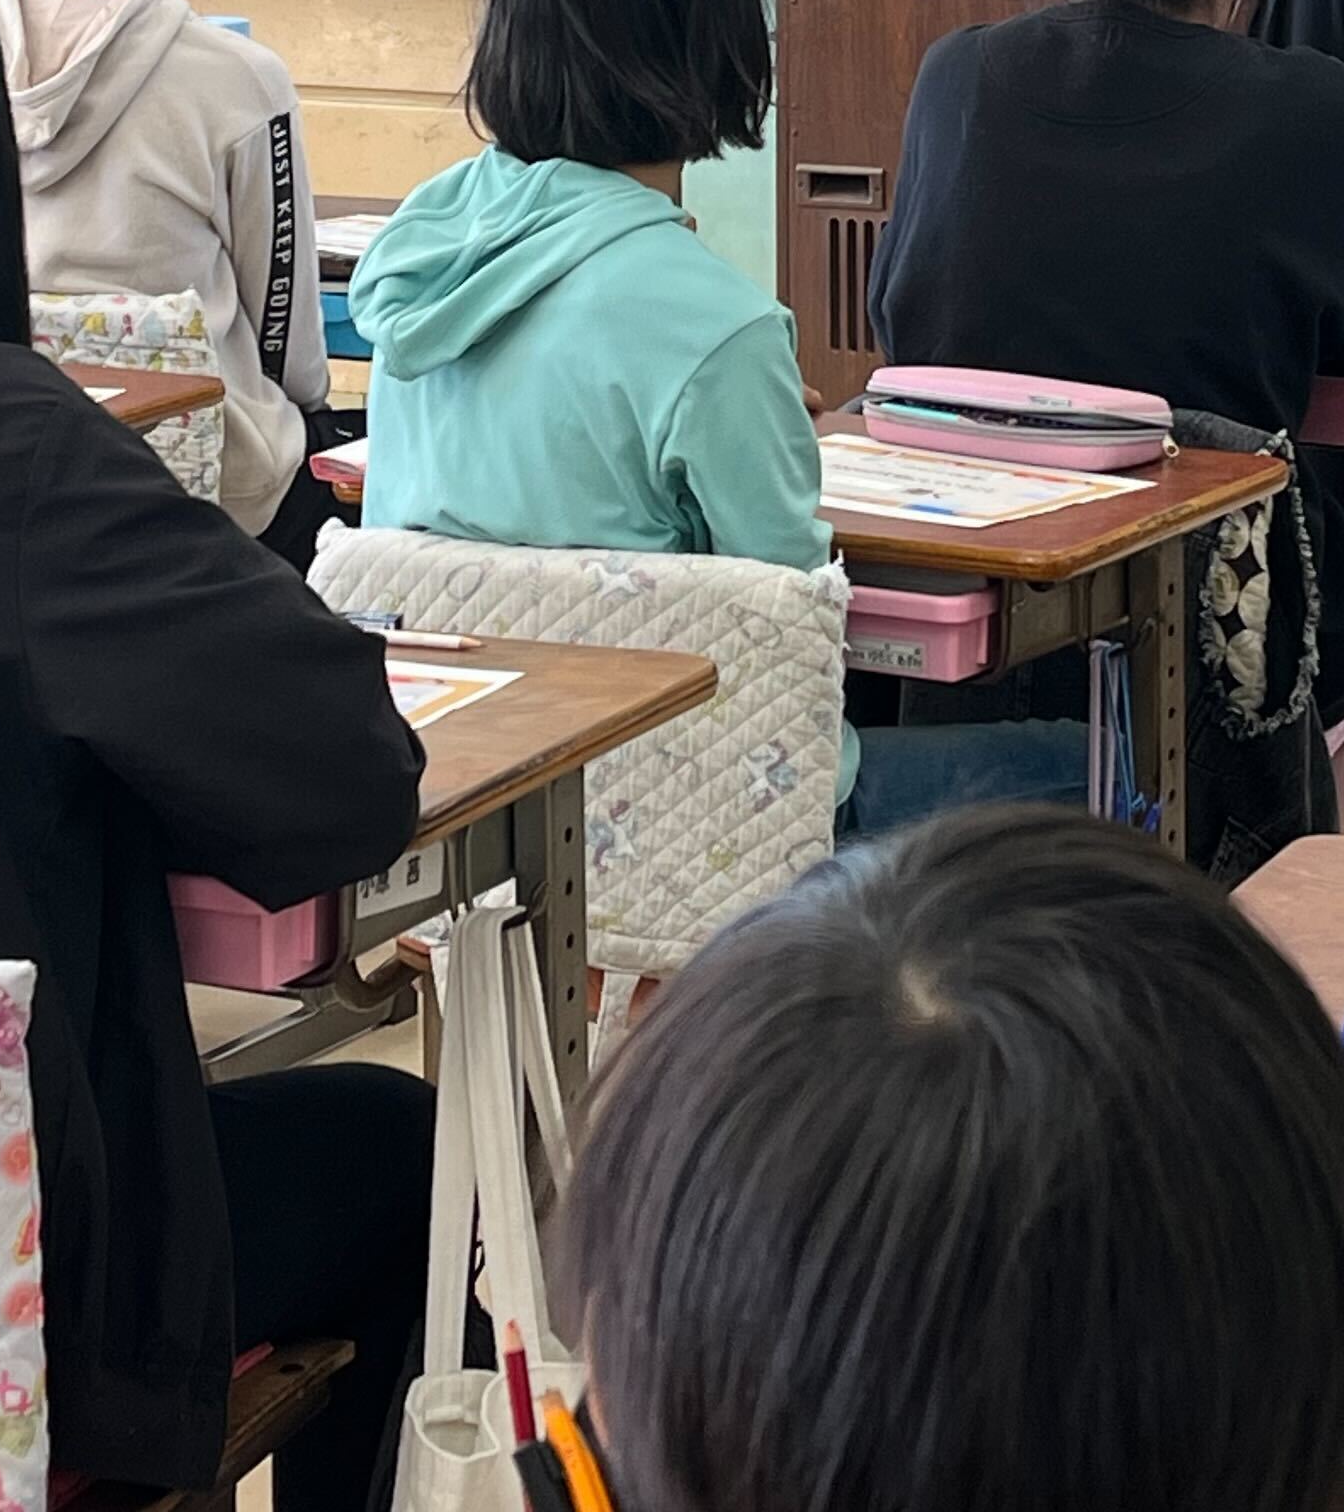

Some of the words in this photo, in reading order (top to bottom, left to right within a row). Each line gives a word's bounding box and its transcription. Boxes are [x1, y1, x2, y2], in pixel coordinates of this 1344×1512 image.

[271, 122, 290, 187] JUST
[275, 198, 293, 265] KEEP
[263, 276, 290, 353] GOING
